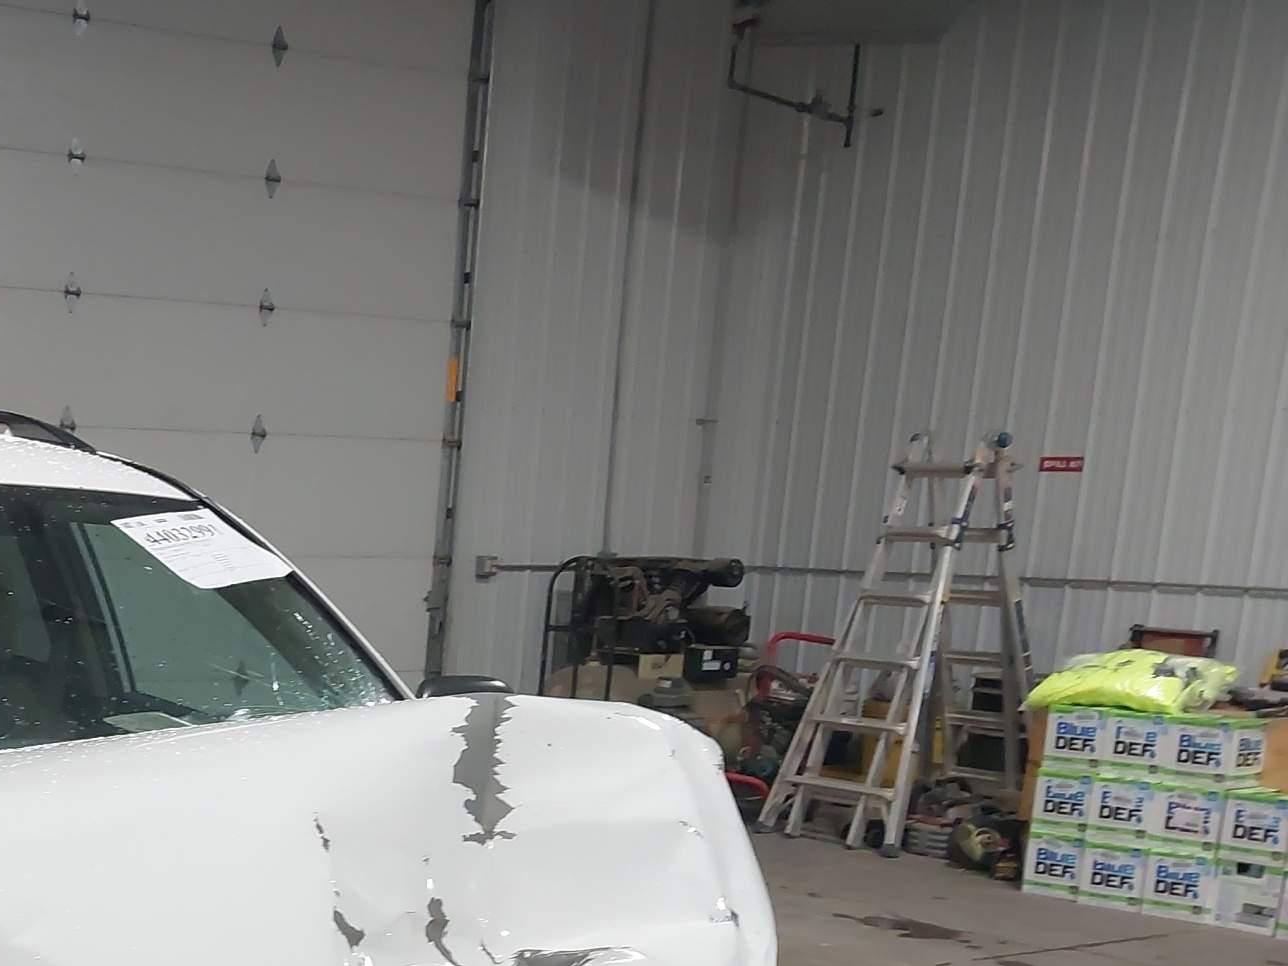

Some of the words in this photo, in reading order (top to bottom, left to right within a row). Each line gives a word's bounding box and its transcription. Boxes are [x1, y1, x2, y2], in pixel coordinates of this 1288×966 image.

[1055, 735, 1096, 752] DEF
[1113, 740, 1156, 757] DEF
[1177, 748, 1221, 766] DEF
[1043, 799, 1085, 815] DEF
[1099, 804, 1143, 822] DEF
[1232, 823, 1280, 843] DEF
[1034, 861, 1076, 878] DEF
[1090, 871, 1135, 889] DEF
[1154, 879, 1199, 897] DEF
